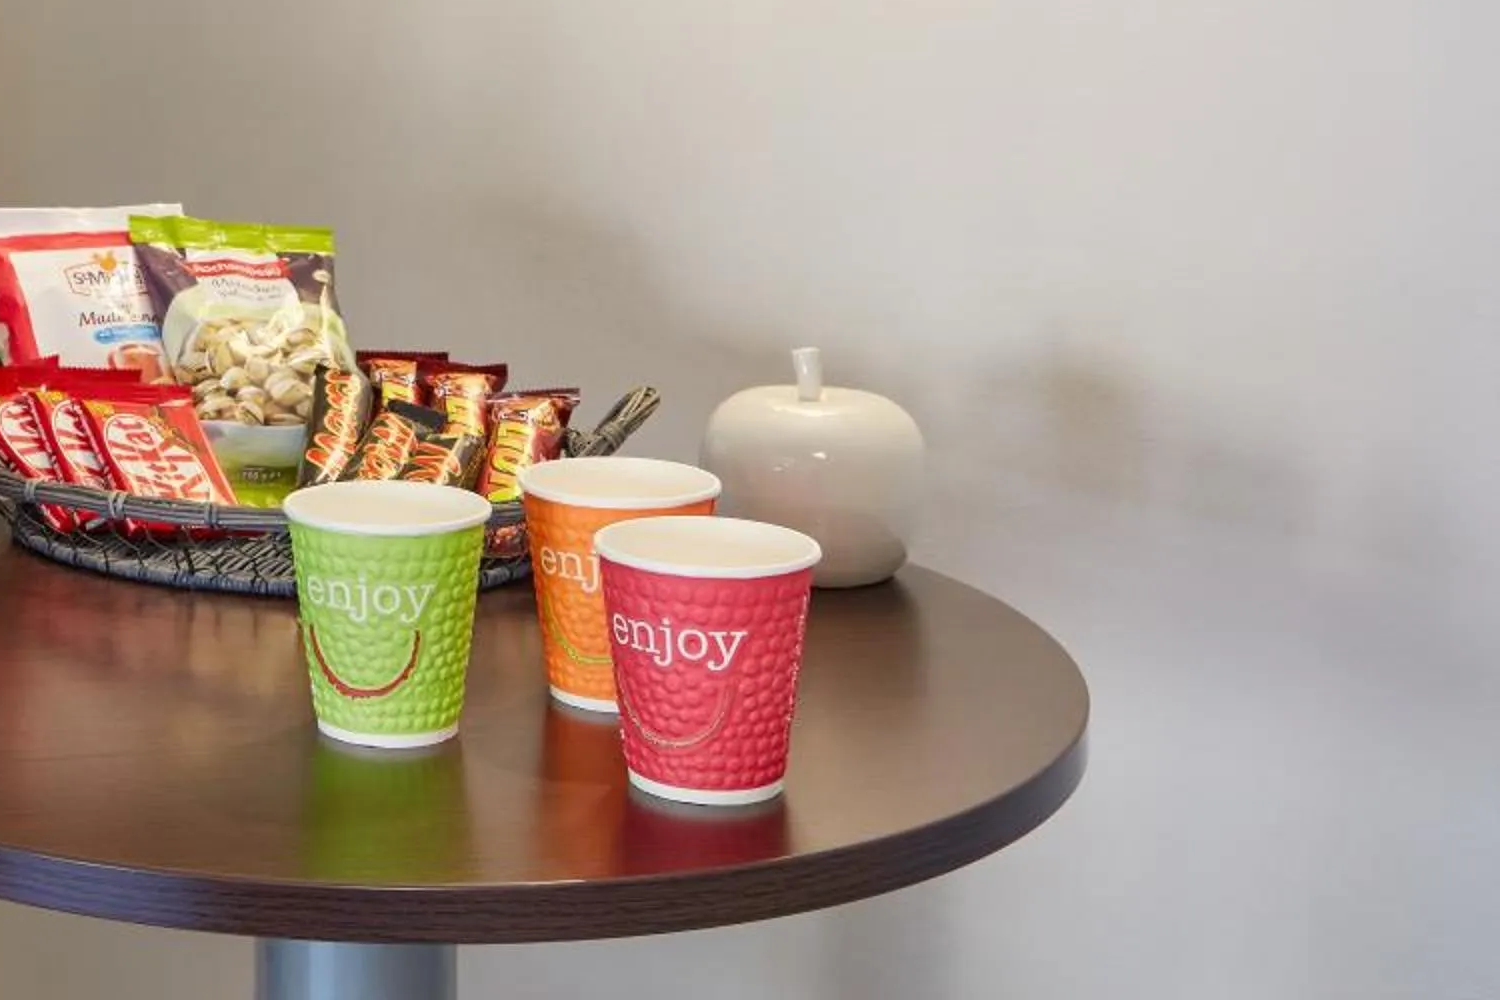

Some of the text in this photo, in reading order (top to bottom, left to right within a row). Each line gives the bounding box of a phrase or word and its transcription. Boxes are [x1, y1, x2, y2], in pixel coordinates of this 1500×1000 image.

[540, 545, 601, 593] enj
[306, 571, 438, 624] enjoy
[612, 612, 749, 672] enjoy
